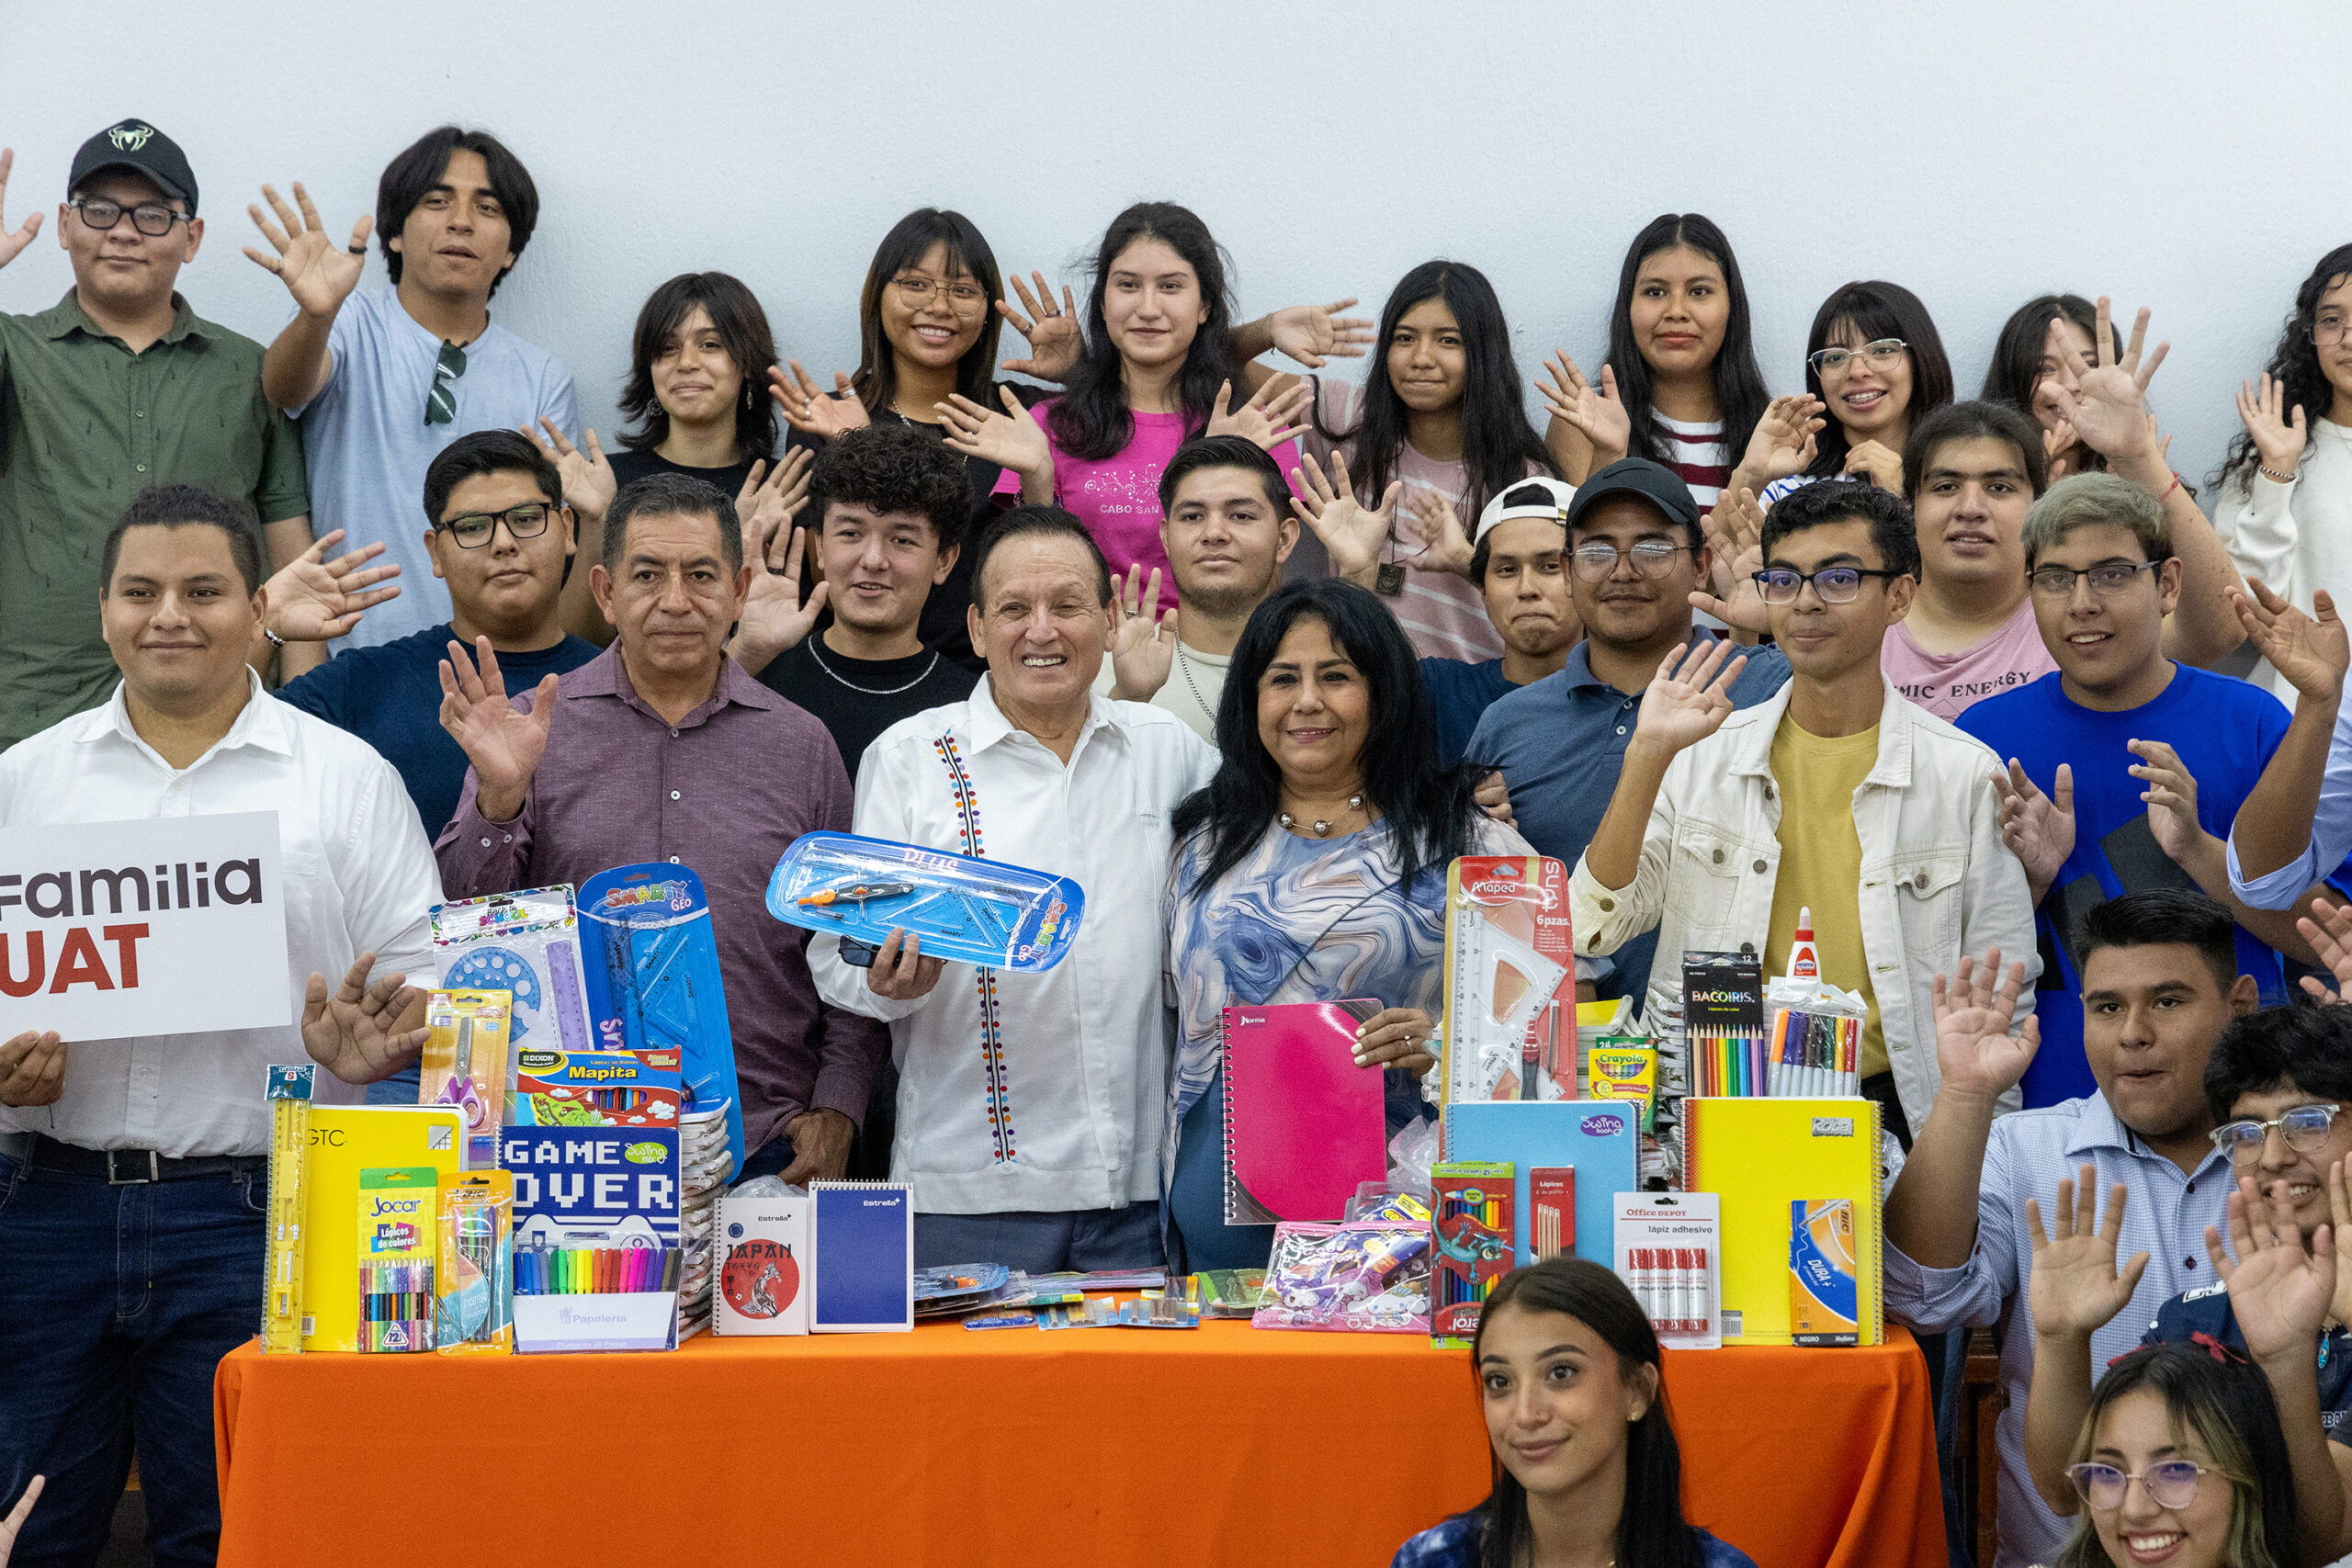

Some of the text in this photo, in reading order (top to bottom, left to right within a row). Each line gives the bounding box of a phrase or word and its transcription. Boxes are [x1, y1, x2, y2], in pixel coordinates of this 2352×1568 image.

[1100, 504, 1159, 514] CABO SAN
[1894, 671, 2031, 699] MIC ENERGY
[0, 858, 263, 919] Familia
[605, 879, 687, 908] SMARTY
[1471, 882, 1516, 894] Maped
[671, 898, 692, 911] GEO
[479, 908, 529, 926] SCHOOL
[1028, 898, 1068, 964] SMARTY
[0, 922, 150, 998] UAT
[1240, 1016, 1266, 1026] Norma
[1600, 1054, 1643, 1065] Crayola
[569, 1066, 637, 1081] Mapita
[1580, 1115, 1623, 1136] Swing
[505, 1140, 668, 1165] GAME Swing
[641, 1155, 656, 1163] mix
[512, 1173, 673, 1209] OVER
[370, 1196, 421, 1217] Jocar
[1648, 1225, 1713, 1234] lápiz adhesivo
[1840, 1211, 1849, 1233] BIC
[380, 1226, 410, 1238] Lápices
[378, 1236, 416, 1249] de colores
[726, 1244, 792, 1259] JAPAN
[726, 1261, 760, 1271] TOKYO
[1453, 1317, 1480, 1331] erol
